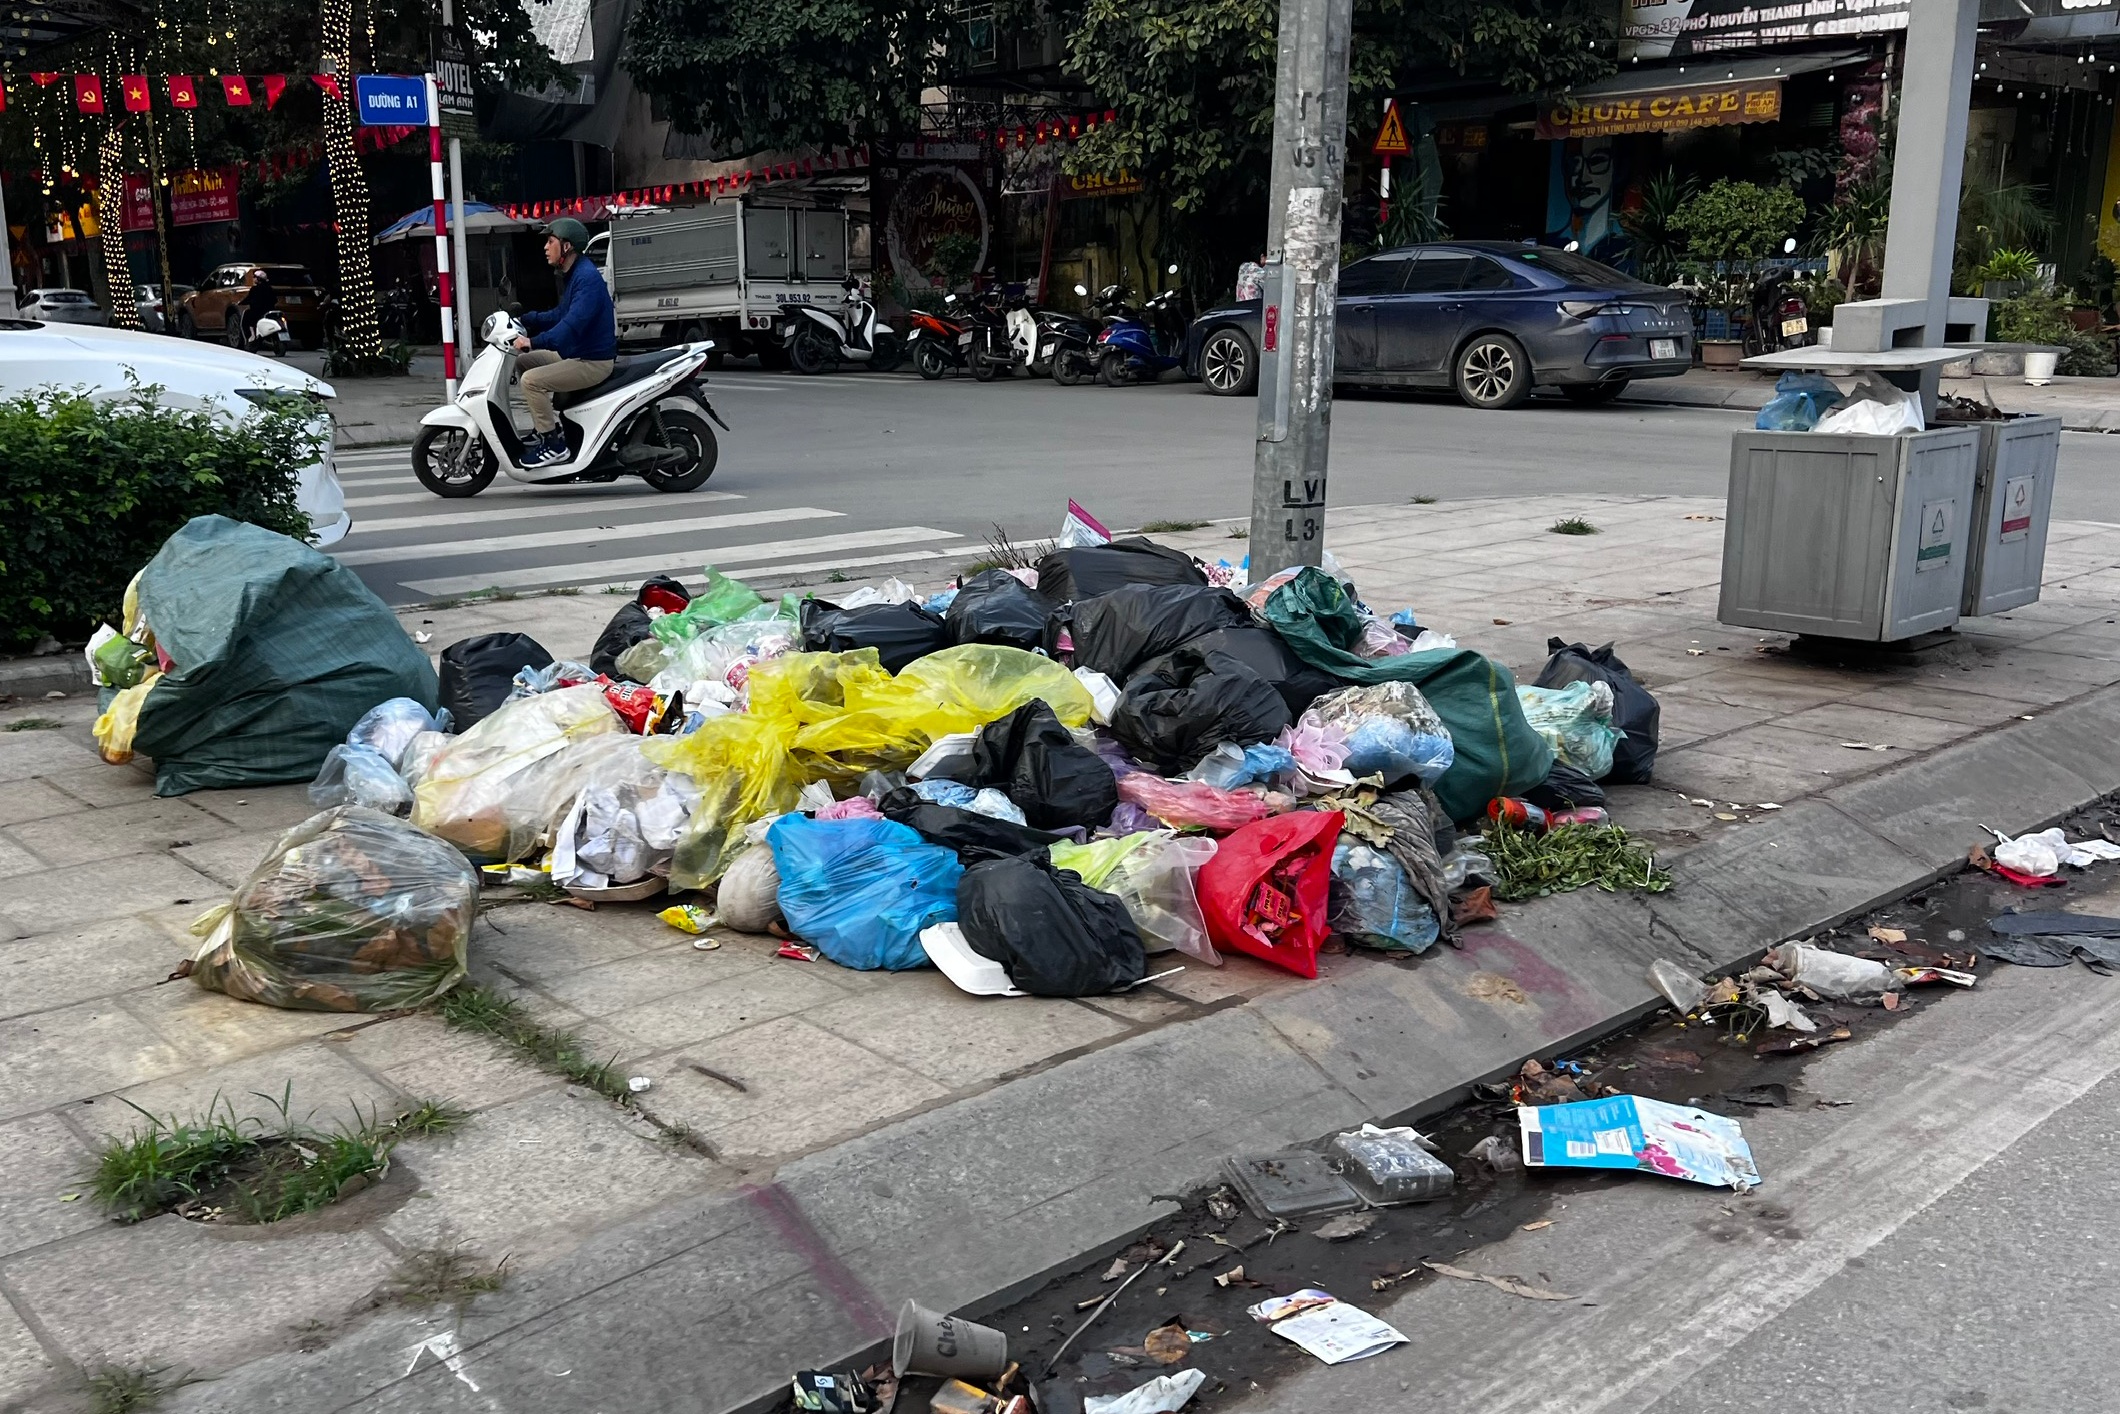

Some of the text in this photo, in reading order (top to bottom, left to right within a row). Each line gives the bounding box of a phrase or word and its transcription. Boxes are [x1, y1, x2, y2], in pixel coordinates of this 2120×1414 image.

[1662, 17, 1680, 32] 32
[1682, 12, 1709, 31] PHỐ
[1760, 3, 1803, 21] THANH
[435, 60, 474, 95] HOTEL
[368, 92, 418, 108] ĐƯỜNG A1
[456, 96, 474, 108] ANH
